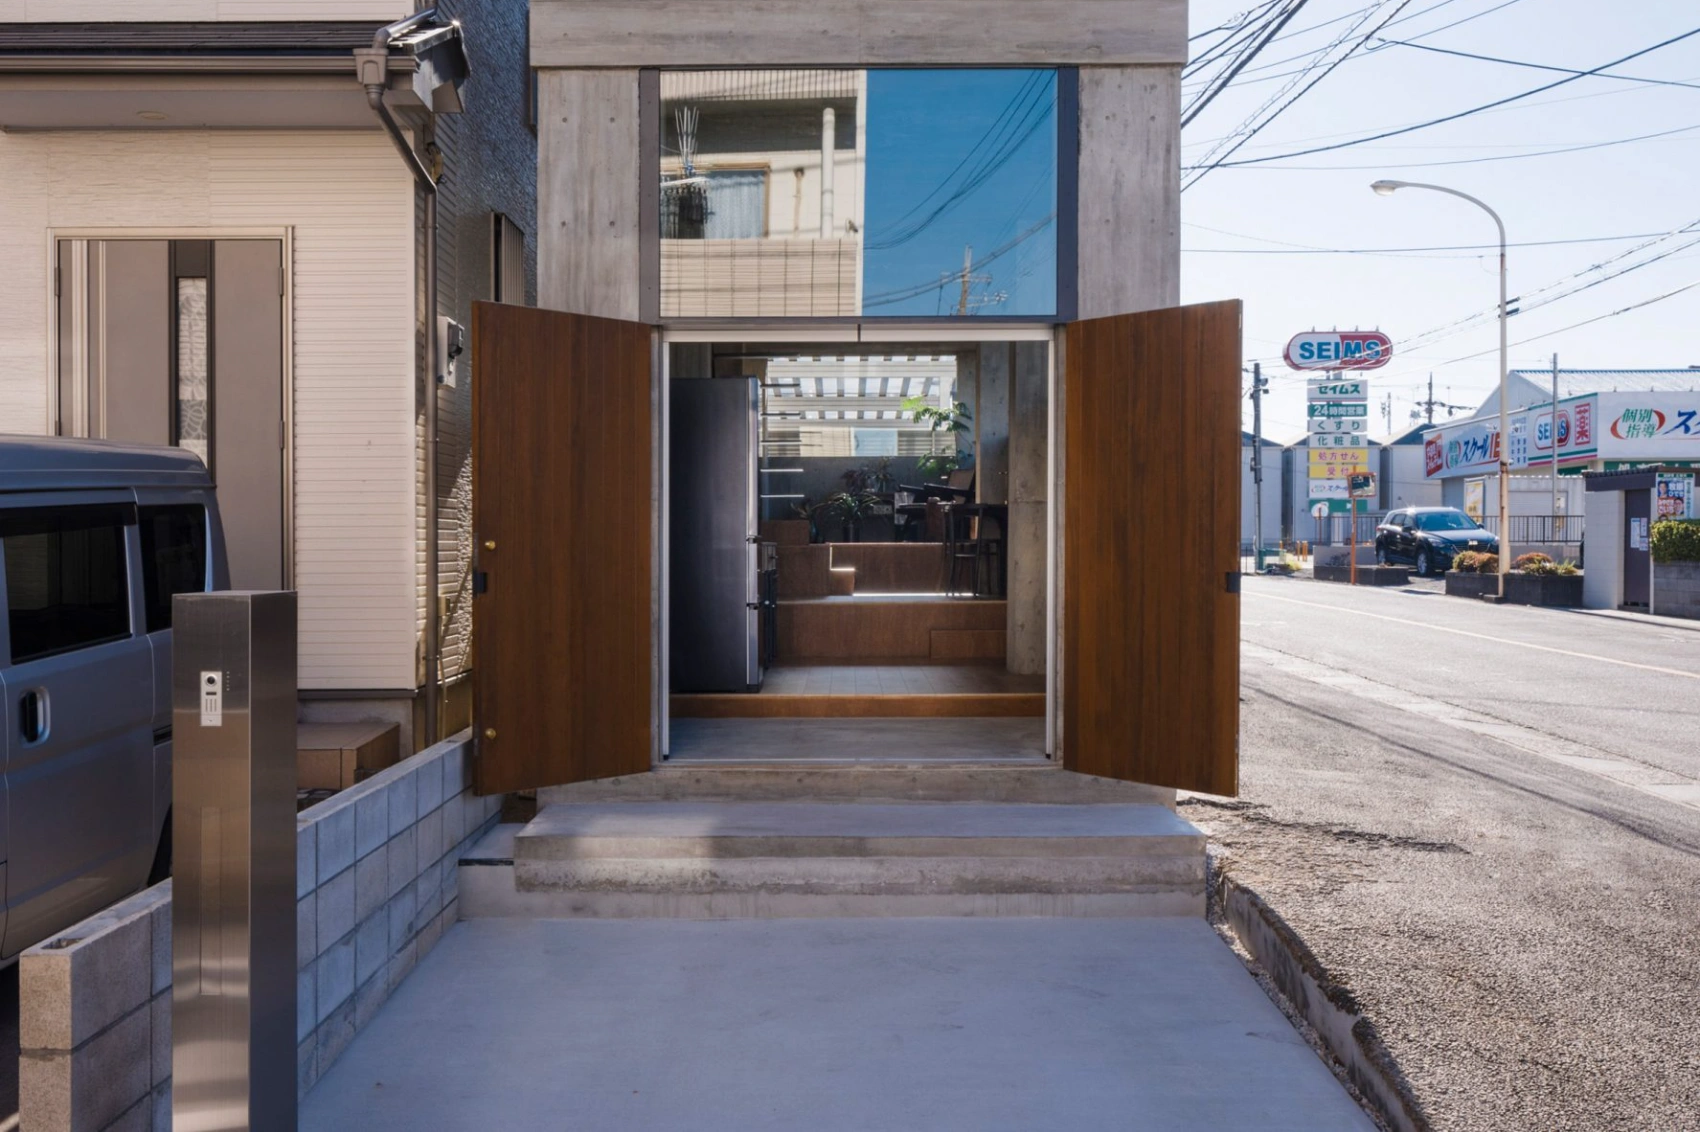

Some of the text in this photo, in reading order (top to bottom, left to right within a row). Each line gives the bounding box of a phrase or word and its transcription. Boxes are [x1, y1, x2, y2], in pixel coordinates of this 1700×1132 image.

[1299, 340, 1381, 360] SEIMS
[1318, 384, 1360, 395] セイムス
[1314, 405, 1365, 416] 24時間営業
[1621, 408, 1653, 424] 個別
[1317, 420, 1360, 431] くすり
[1662, 409, 1700, 436] ス
[1318, 436, 1360, 446] 化粧品
[1318, 451, 1359, 461] 処方せん
[1327, 466, 1349, 476] 受付
